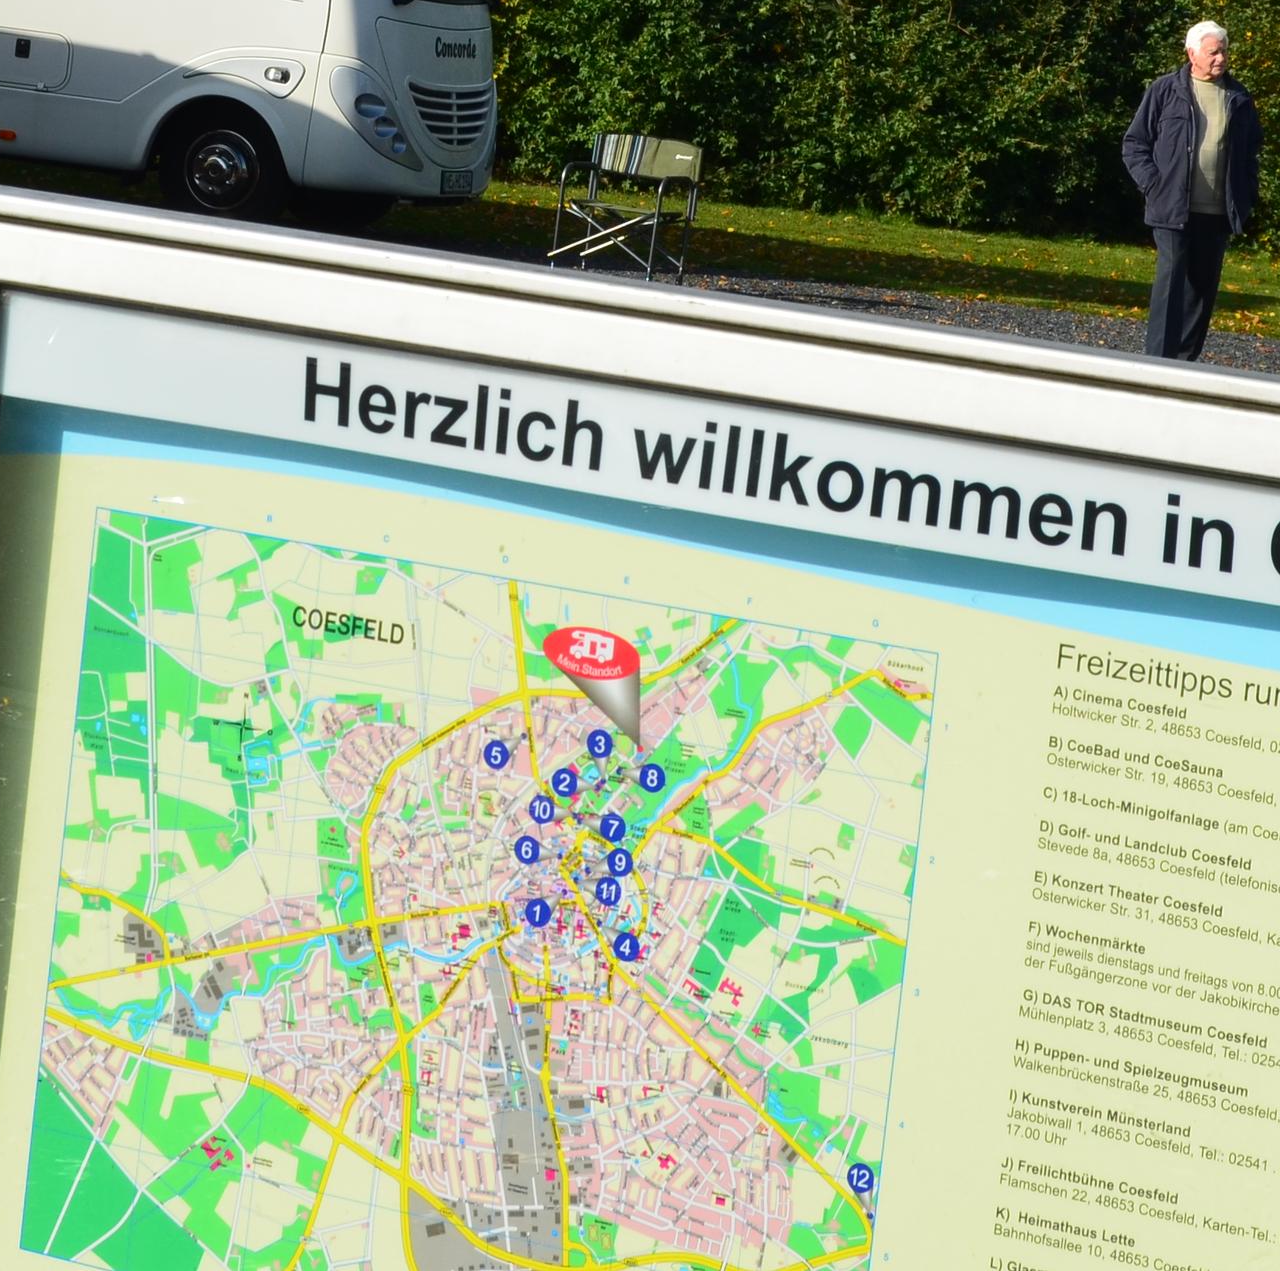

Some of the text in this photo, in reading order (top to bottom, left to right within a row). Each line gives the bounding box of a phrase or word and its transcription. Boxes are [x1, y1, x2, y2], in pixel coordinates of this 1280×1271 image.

[435, 36, 477, 59] Concorde
[304, 357, 604, 471] Herzlich
[635, 426, 1127, 556] willkommen
[1163, 496, 1234, 573] in
[292, 605, 406, 646] COESFELD
[556, 654, 624, 678] Mein Standort
[1055, 641, 1233, 702] Freizeittipps
[1052, 684, 1188, 721] A) Cinema Coesfeld
[595, 736, 605, 753] 3
[1051, 700, 1118, 725] Holtwicker
[1119, 712, 1142, 730] Str.
[1143, 717, 1158, 734] 2,
[1159, 720, 1202, 741] 48653
[1204, 727, 1266, 753] Coesfeld,
[491, 747, 501, 764] 5
[647, 769, 657, 787] 8
[1047, 734, 1224, 779] B) CoeBad und CoeSauna
[558, 774, 570, 791] 2
[1045, 751, 1122, 778] Osterwicker
[1123, 765, 1145, 783] Str.
[1150, 770, 1170, 789] 19,
[1171, 774, 1214, 795] 48653
[1215, 782, 1278, 809] Coesfeld,
[532, 801, 551, 819] 10
[608, 820, 619, 837] 7
[1042, 785, 1059, 804] C)
[1061, 788, 1221, 833] 18-Loch-Minigolfanlage
[1222, 818, 1249, 837] (am
[521, 841, 532, 859] 6
[615, 854, 626, 871] 9
[1036, 835, 1090, 859] Stevede
[1091, 845, 1112, 865] 8a,
[1114, 850, 1157, 871] 48653
[1158, 858, 1217, 883] Coesfeld
[1038, 818, 1253, 872] D) Golf- und Landclub Coesfeld
[533, 905, 541, 921] 1
[600, 883, 617, 901] 11
[1032, 869, 1224, 919] E) Konzert Theater Coesfeld
[1027, 919, 1147, 956] F) Wochenmärkte
[1031, 886, 1108, 913] Osterwicker
[1108, 900, 1131, 919] Str.
[1133, 905, 1154, 924] 31,
[1156, 911, 1199, 931] 48653
[1201, 918, 1263, 945] Coesfeld,
[620, 939, 631, 956] 4
[1023, 953, 1047, 970] der
[1047, 957, 1149, 991] Fußgängerzone
[1150, 981, 1173, 996] vor
[1174, 983, 1198, 1000] der
[1198, 988, 1280, 1017] Jakobikirche
[1017, 1003, 1096, 1033] Mühlenplatz
[1096, 1019, 1110, 1037] 3,
[1112, 1023, 1154, 1044] 48653
[1156, 1031, 1218, 1059] Coesfeld,
[1220, 1043, 1248, 1064] Tel.:
[1021, 987, 1269, 1050] G) DAS TOR Stadtmuseum Coesfeld
[1014, 1037, 1249, 1099] H) Puppen- und Spielzeugmuseum
[1008, 1087, 1192, 1139] I) Kunstverein Münsterland
[850, 1169, 870, 1189] 12
[999, 1155, 1180, 1206] J) Freilichtbühne Coesfeld
[994, 1204, 1136, 1249] K) Heimathaus Lette
[998, 1171, 1069, 1200] Flamschen
[1070, 1186, 1092, 1206] 22,
[1093, 1192, 1136, 1214] 48653
[1137, 1201, 1199, 1229] Coesfeld,
[1201, 1215, 1277, 1245] Karten-Tel.:
[992, 1221, 1083, 1254] Bahnhofsallee
[1086, 1242, 1106, 1261] 10,
[1108, 1247, 1150, 1269] 48653
